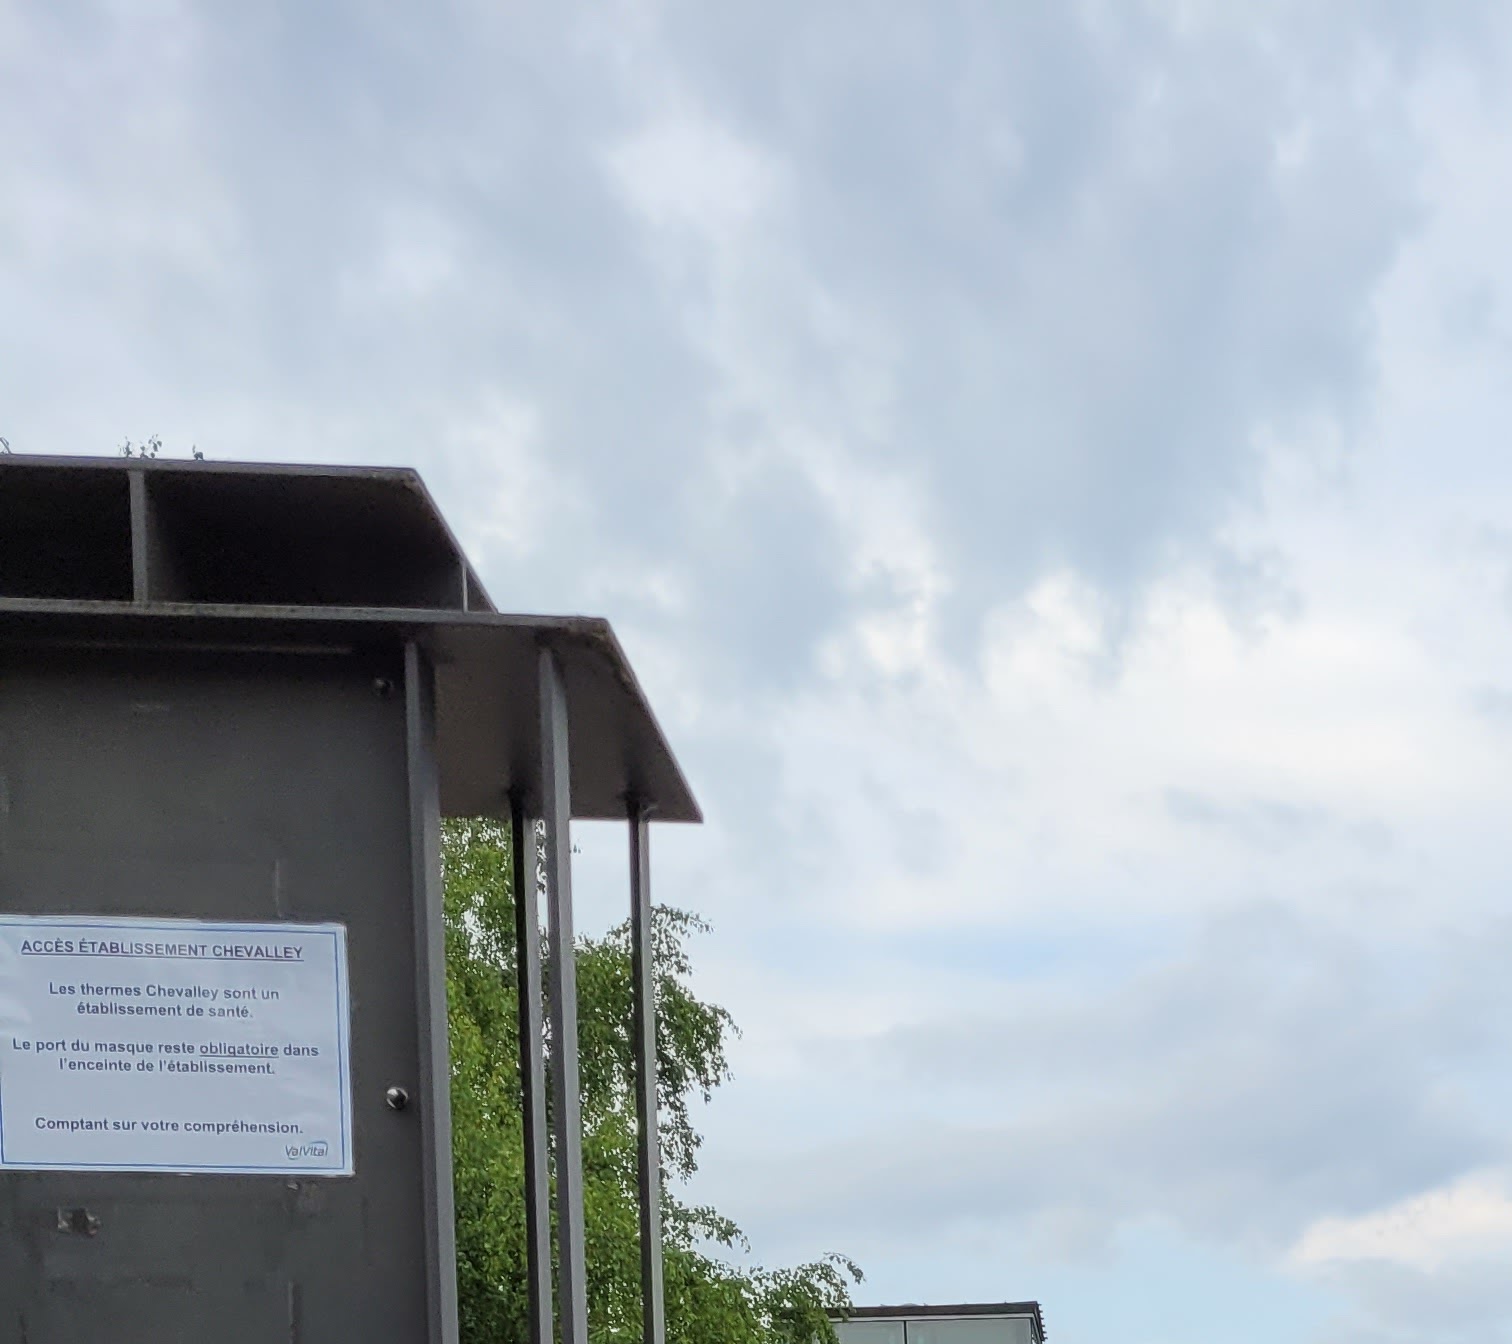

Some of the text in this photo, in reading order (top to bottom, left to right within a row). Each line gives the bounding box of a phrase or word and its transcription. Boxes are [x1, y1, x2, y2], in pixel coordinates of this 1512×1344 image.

[20, 938, 303, 959] ACCÈS ÉTABLISSEMENT CHEVALLEY
[49, 982, 280, 1002] Les thermes Chevalley sont un
[76, 1002, 253, 1018] établissement de santé.
[12, 1038, 320, 1058] Le port du masque reste obligatoire dans
[59, 1058, 276, 1075] l'enceinte de l'établissement.
[35, 1117, 304, 1136] Comptant sur votre compréhension.
